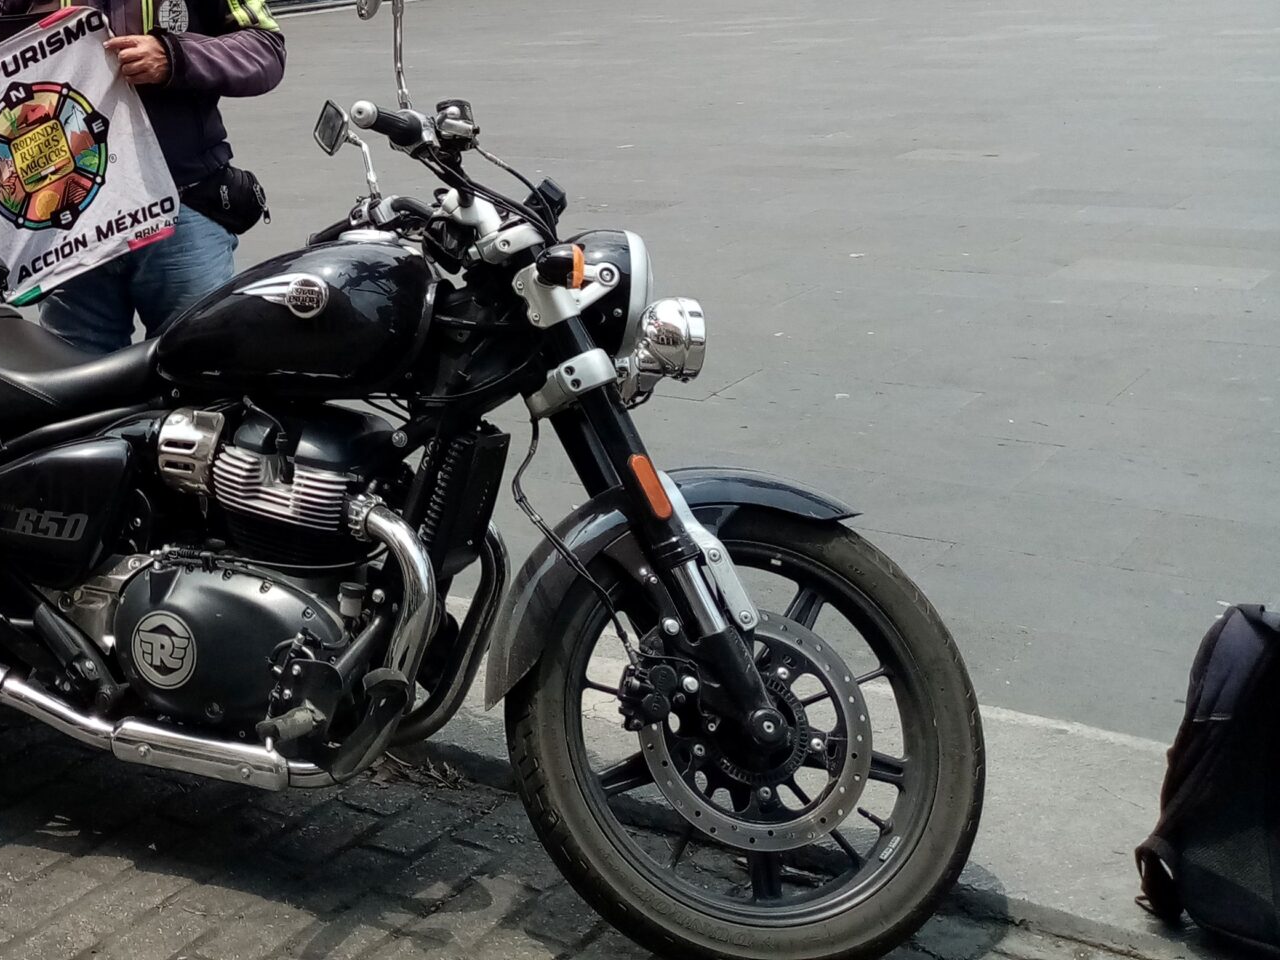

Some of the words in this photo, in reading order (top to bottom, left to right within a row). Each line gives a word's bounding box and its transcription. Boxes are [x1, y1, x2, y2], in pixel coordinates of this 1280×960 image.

[9, 86, 26, 102] N
[91, 119, 105, 133] E
[59, 210, 73, 225] S
[17, 233, 89, 285] ACCIÓN
[95, 195, 175, 242] MÉXICO
[15, 507, 89, 541] 650
